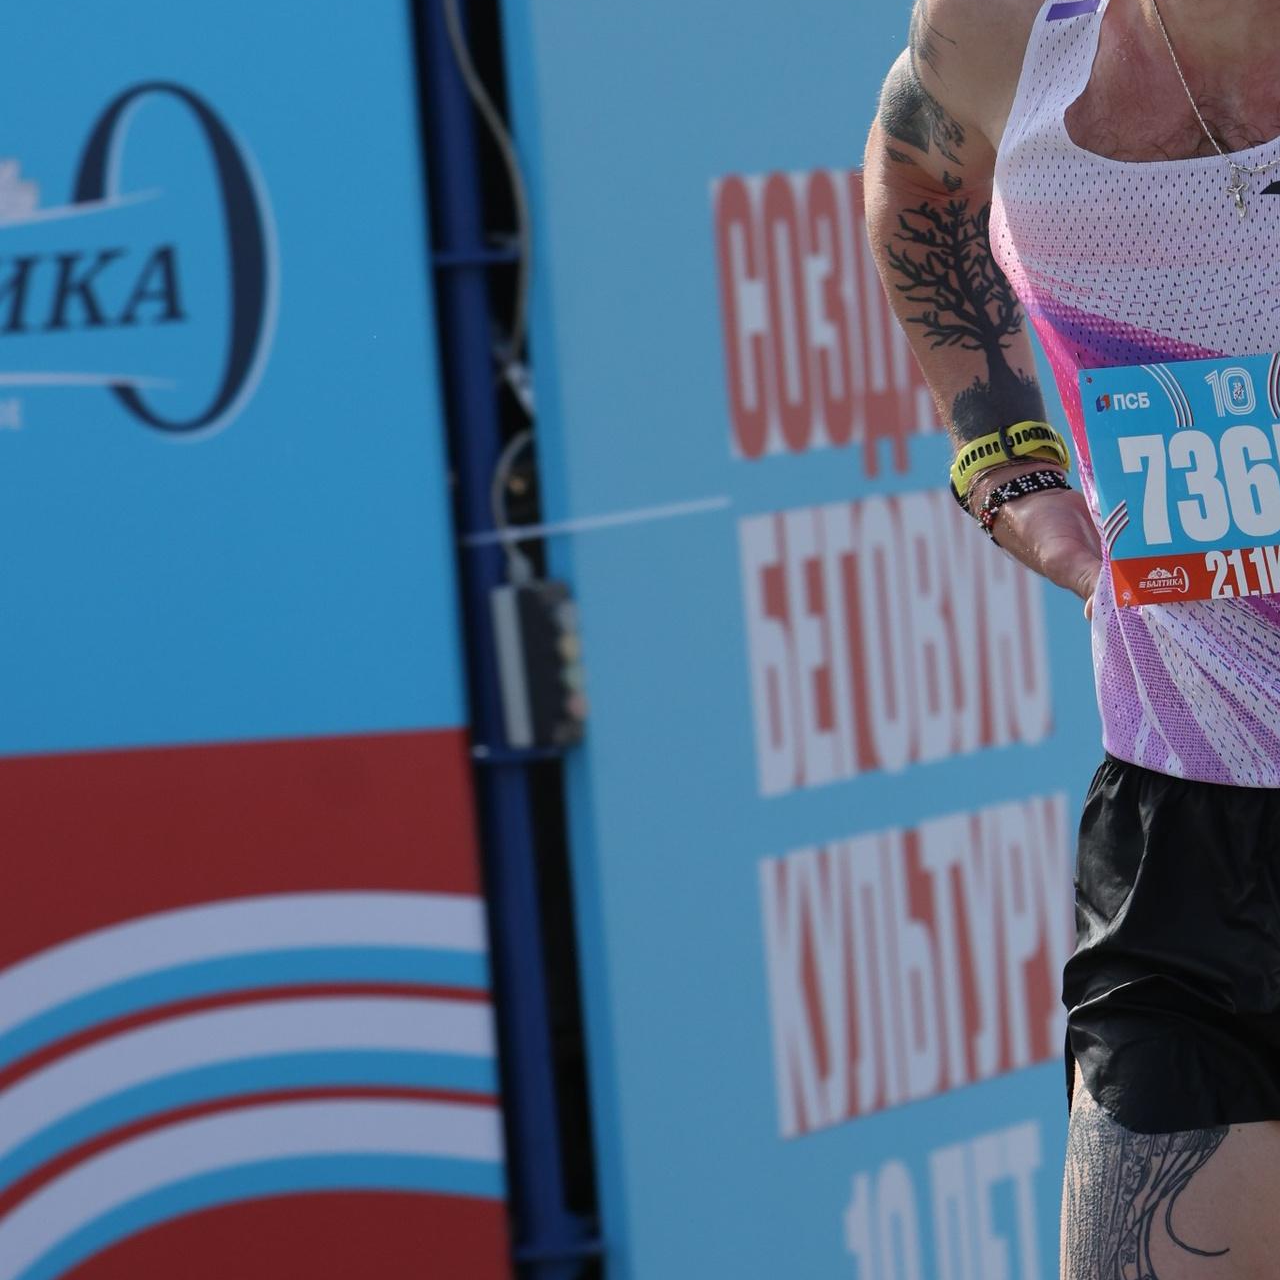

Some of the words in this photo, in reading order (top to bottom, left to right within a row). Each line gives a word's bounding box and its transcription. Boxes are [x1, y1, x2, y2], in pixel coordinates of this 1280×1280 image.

[1113, 392, 1150, 411] ПСБ
[1204, 367, 1256, 418] 10
[1146, 578, 1183, 588] БАЛТИКА
[738, 488, 1054, 798] БЕГОВУЮ
[759, 793, 1076, 1141] КУЛЬТУРУ
